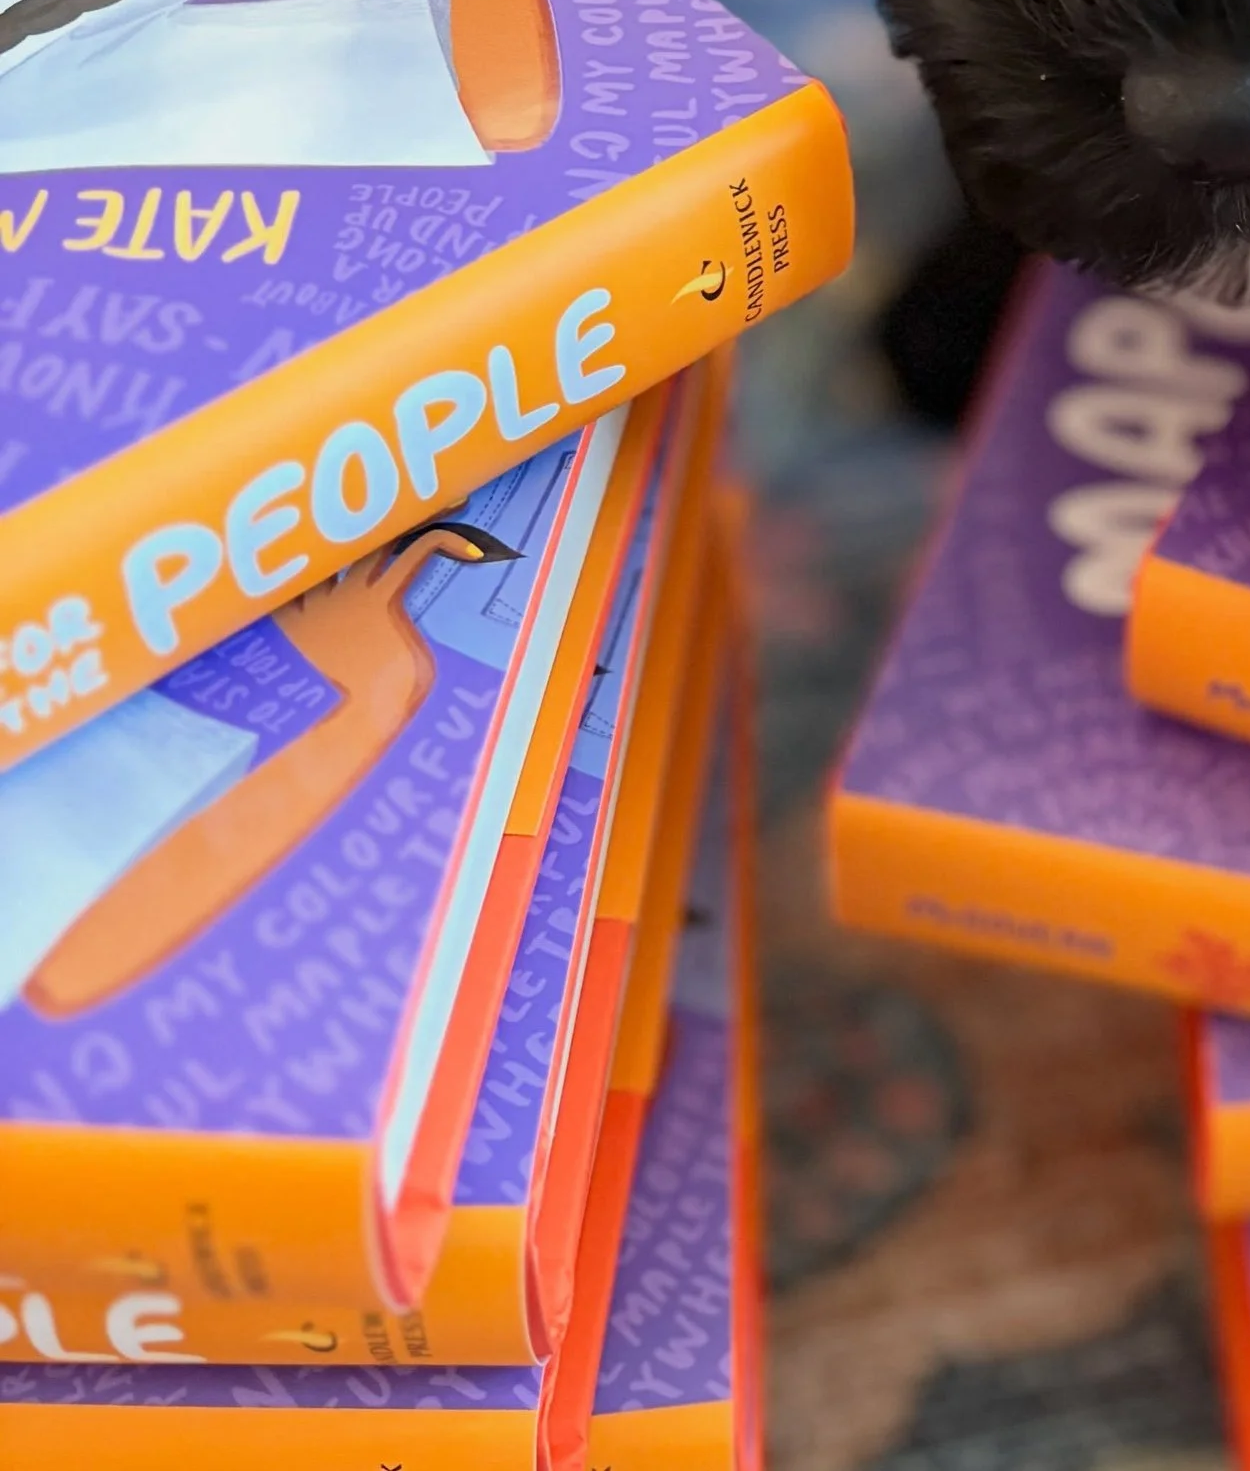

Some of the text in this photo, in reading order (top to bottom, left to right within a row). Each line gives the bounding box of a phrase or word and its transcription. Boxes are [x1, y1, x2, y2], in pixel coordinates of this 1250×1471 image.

[581, 59, 636, 116] MY
[62, 186, 301, 266] KATE
[348, 182, 504, 228] PEOPLE
[767, 204, 789, 274] PRESS
[729, 177, 764, 323] CANDLEWICK
[37, 284, 204, 355] SAY
[122, 287, 627, 657] PEOPLE
[143, 949, 247, 1048] MY
[253, 686, 498, 950] COLOURFUL
[241, 872, 420, 1055] MAPLE
